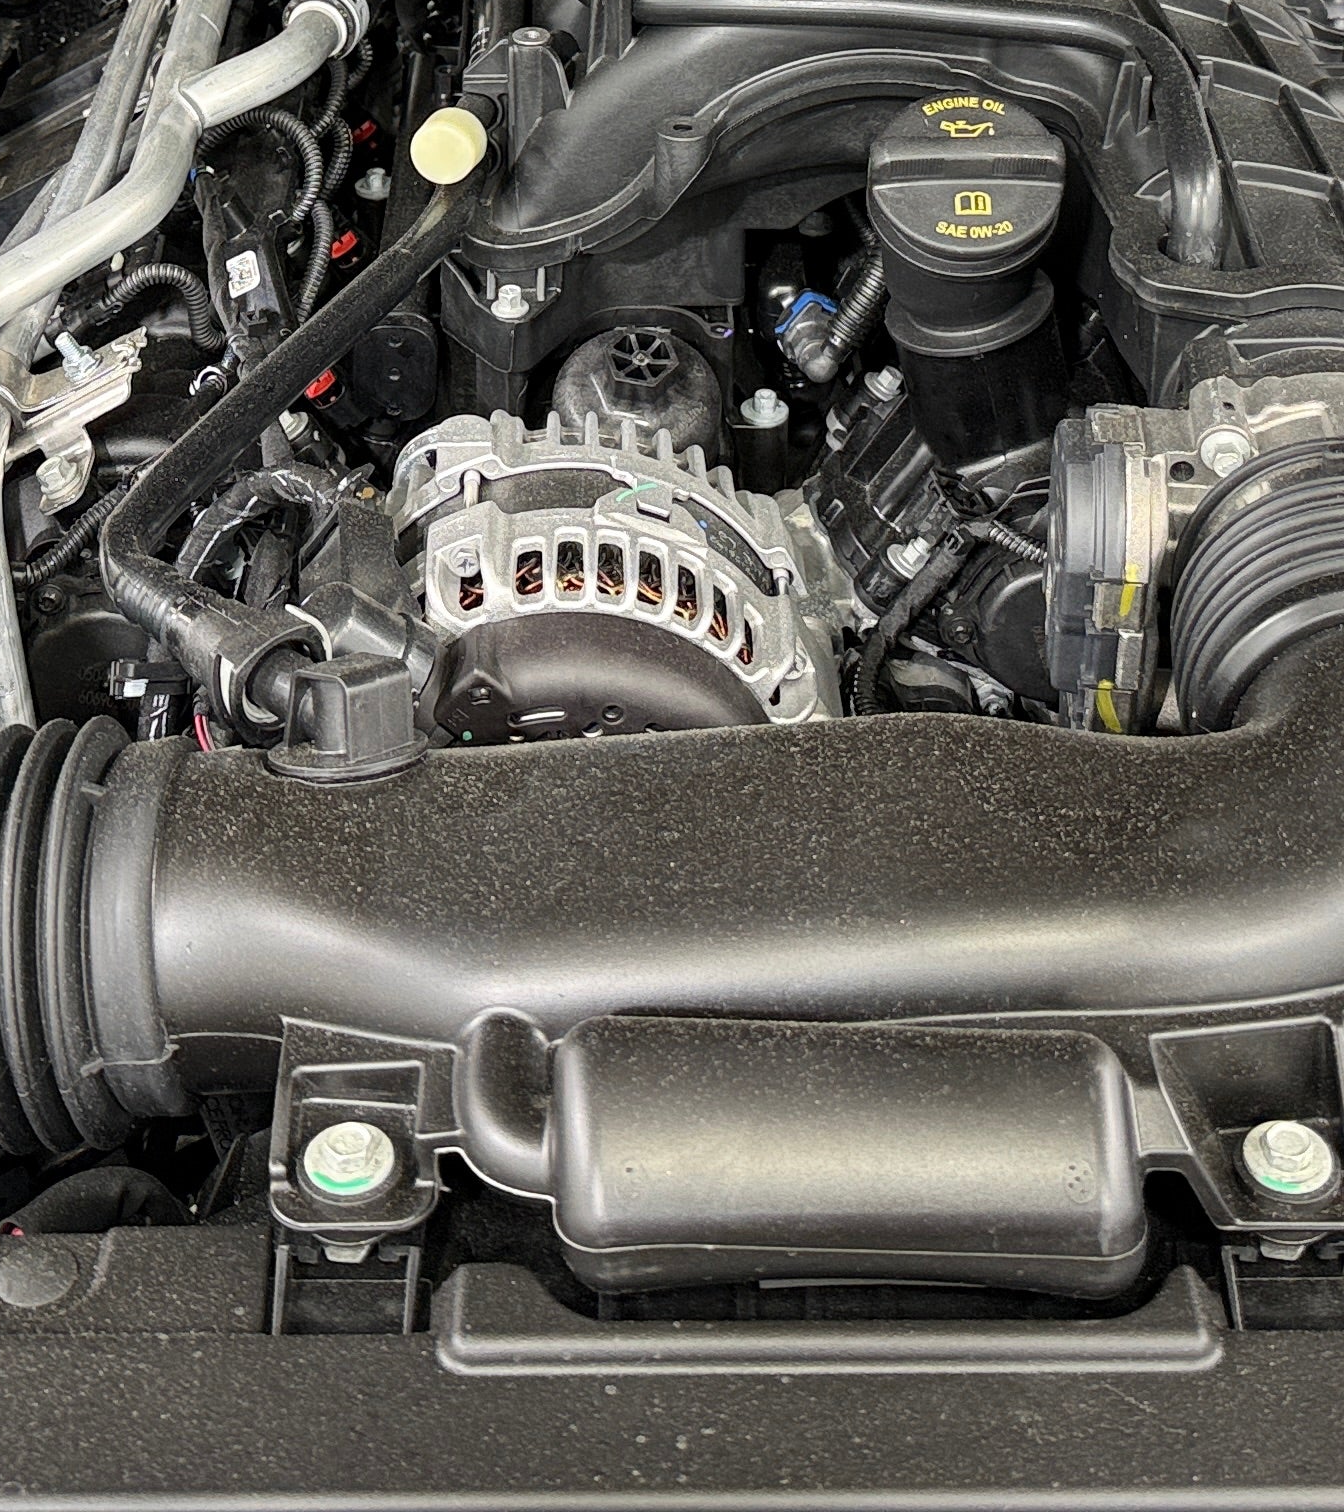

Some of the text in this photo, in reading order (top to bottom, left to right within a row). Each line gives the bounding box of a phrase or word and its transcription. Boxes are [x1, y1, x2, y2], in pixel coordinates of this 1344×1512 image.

[921, 97, 1006, 117] ENGINE OIL
[935, 220, 1014, 239] SAE 0W-20
